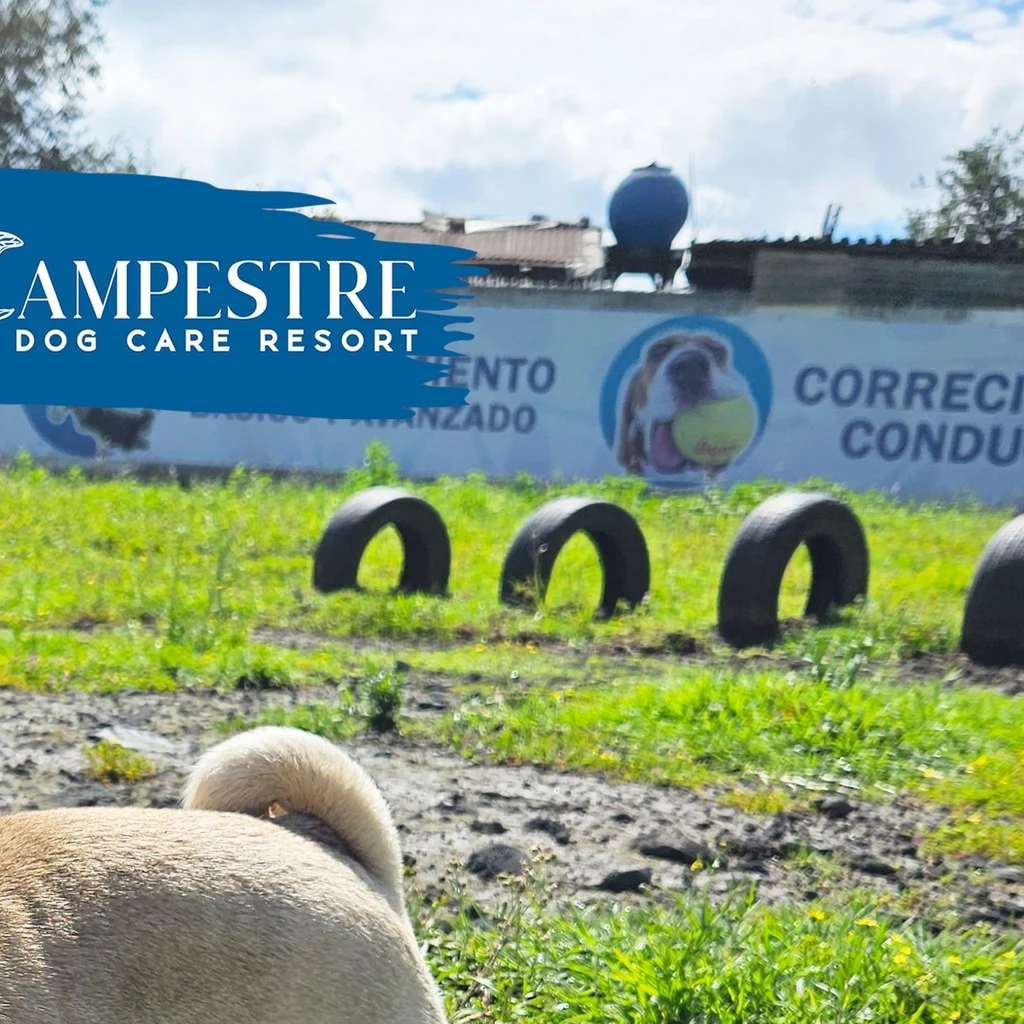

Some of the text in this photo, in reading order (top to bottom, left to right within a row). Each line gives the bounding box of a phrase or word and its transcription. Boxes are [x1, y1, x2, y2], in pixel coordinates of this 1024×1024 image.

[416, 355, 557, 394] ENTO
[351, 403, 538, 435] NZADO
[840, 418, 1024, 467] CONDU
